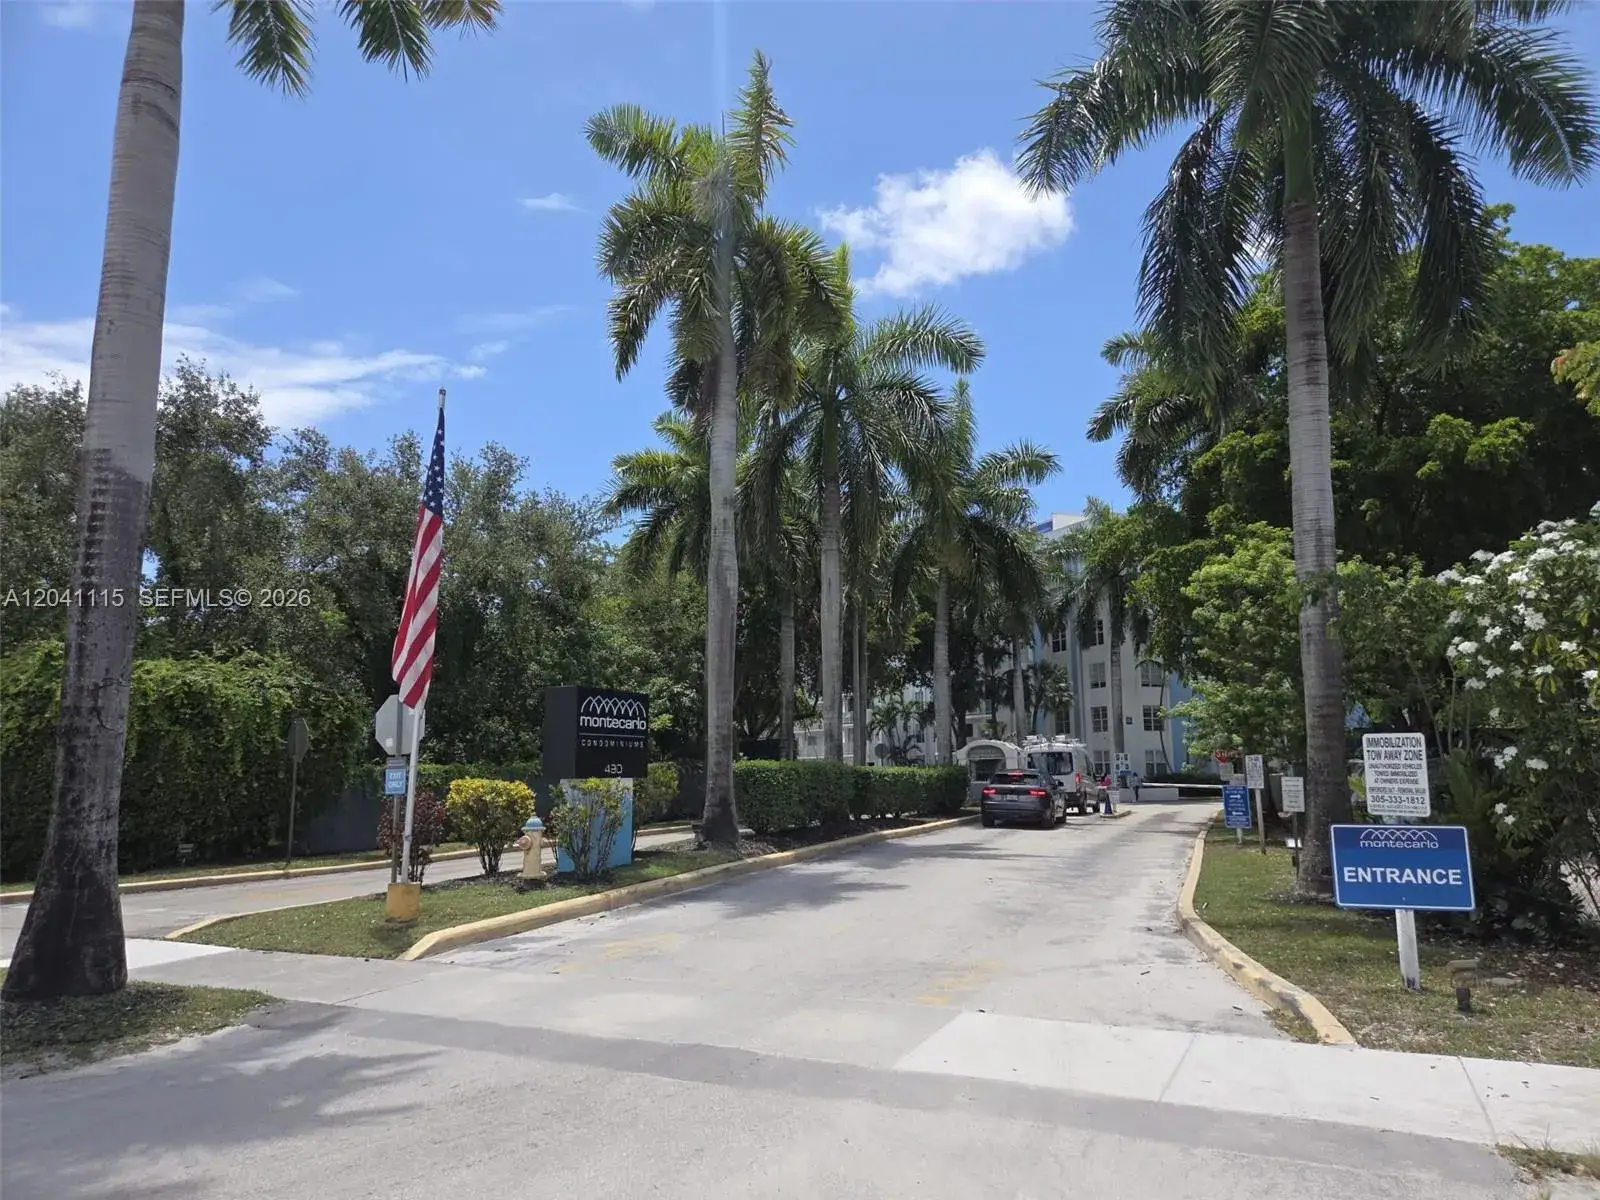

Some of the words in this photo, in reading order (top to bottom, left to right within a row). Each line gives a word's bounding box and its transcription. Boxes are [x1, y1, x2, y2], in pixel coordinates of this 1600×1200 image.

[580, 716, 647, 730] montecarlo
[581, 739, 644, 748] CONDOMINIUMS
[1366, 737, 1422, 748] IMMOBILIZATION
[1367, 750, 1382, 760] TOW
[1384, 750, 1402, 760] AWAY
[1404, 749, 1423, 760] ZONE
[388, 780, 402, 788] ONLY
[1371, 795, 1425, 804] 305-333-1812
[1360, 839, 1439, 849] montecarlo
[1343, 866, 1463, 885] ENTRANCE
